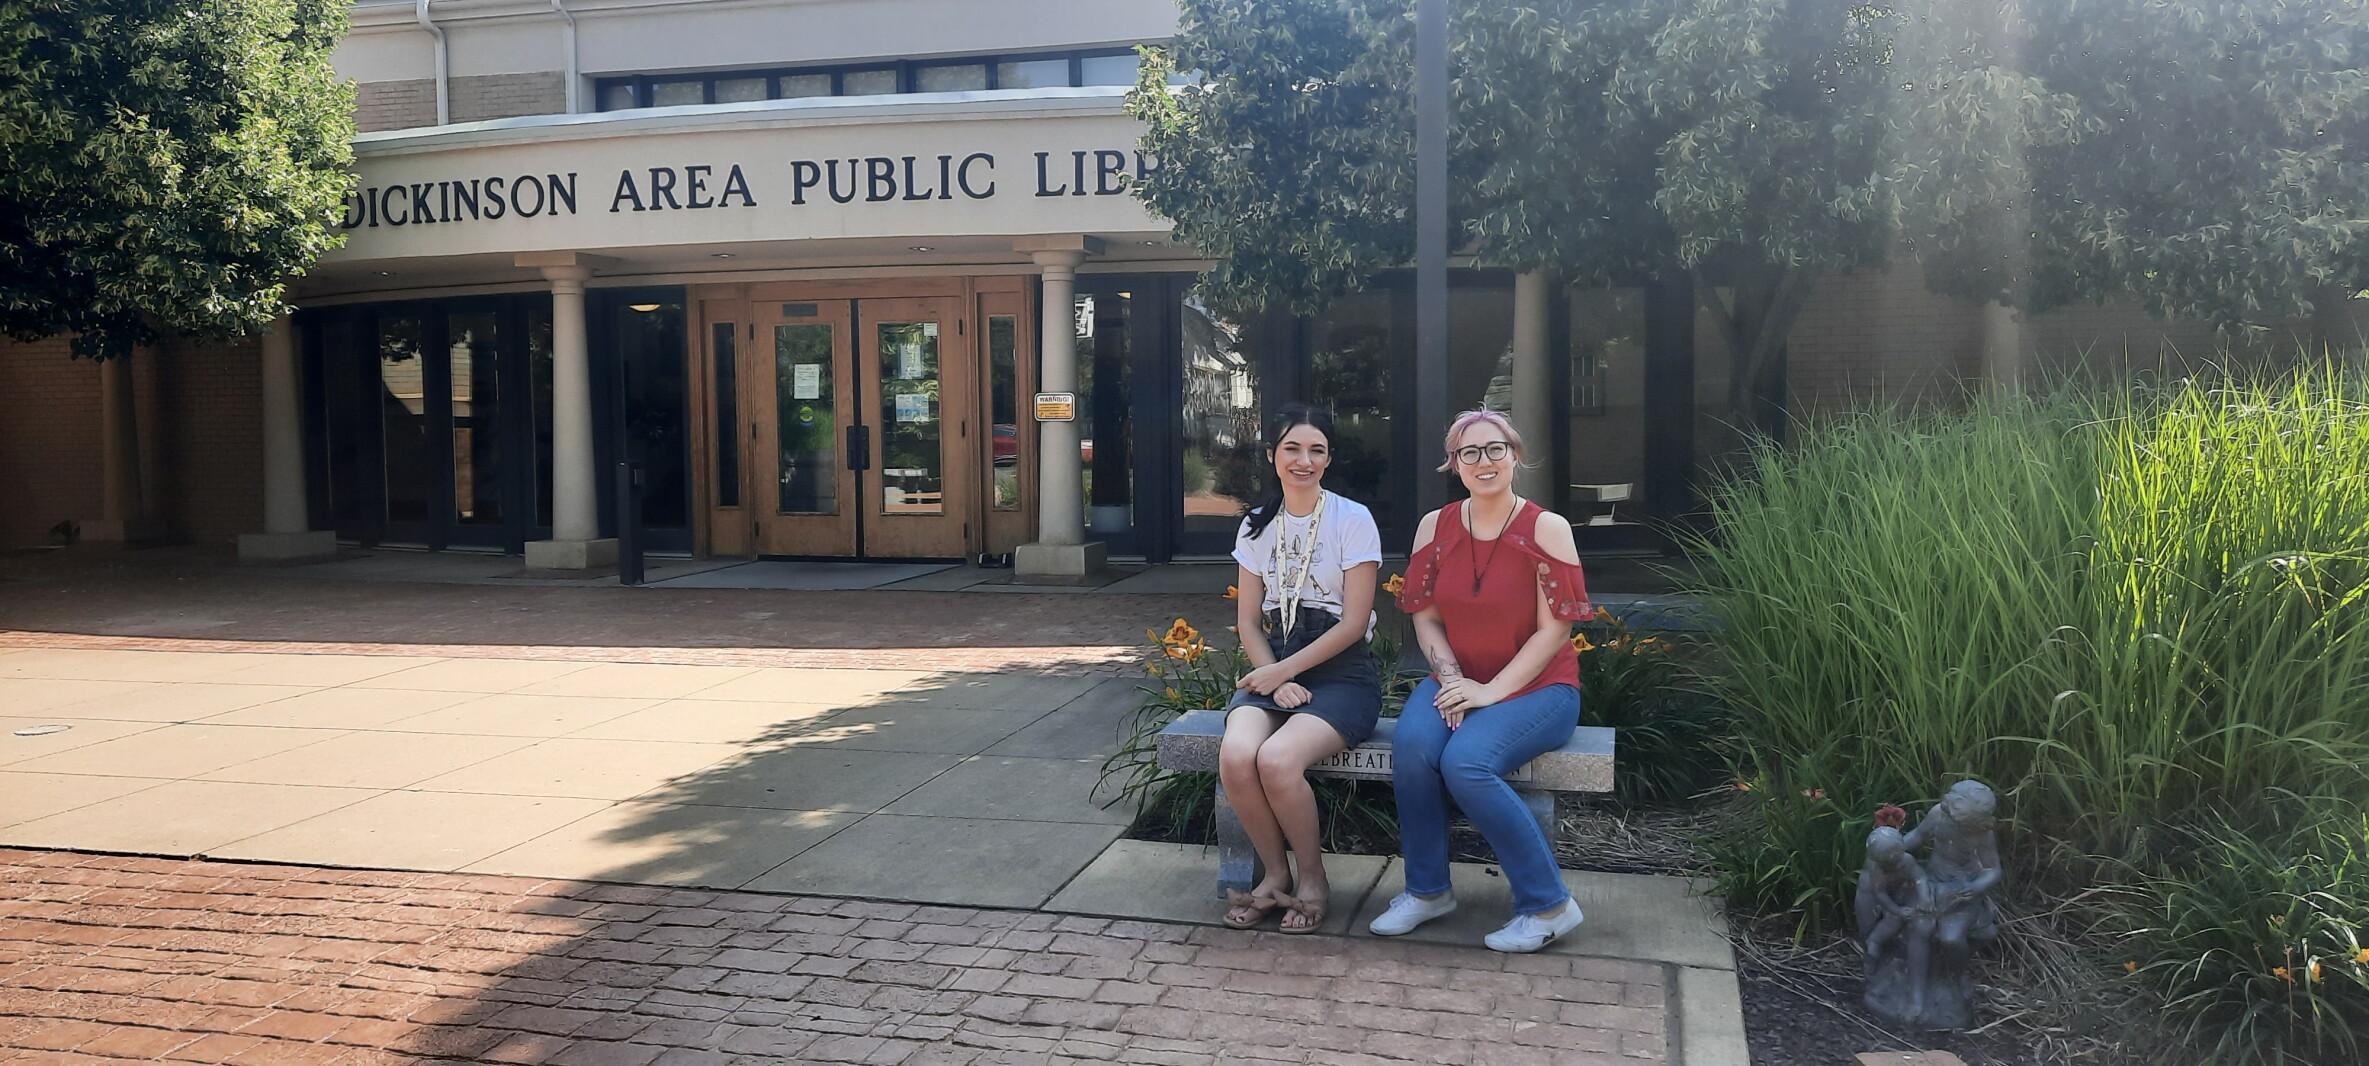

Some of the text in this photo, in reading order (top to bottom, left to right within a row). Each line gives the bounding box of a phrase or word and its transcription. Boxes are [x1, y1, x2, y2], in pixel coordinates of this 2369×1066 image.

[341, 150, 1165, 229] DICKINSON AREA PUBLIC LIBR
